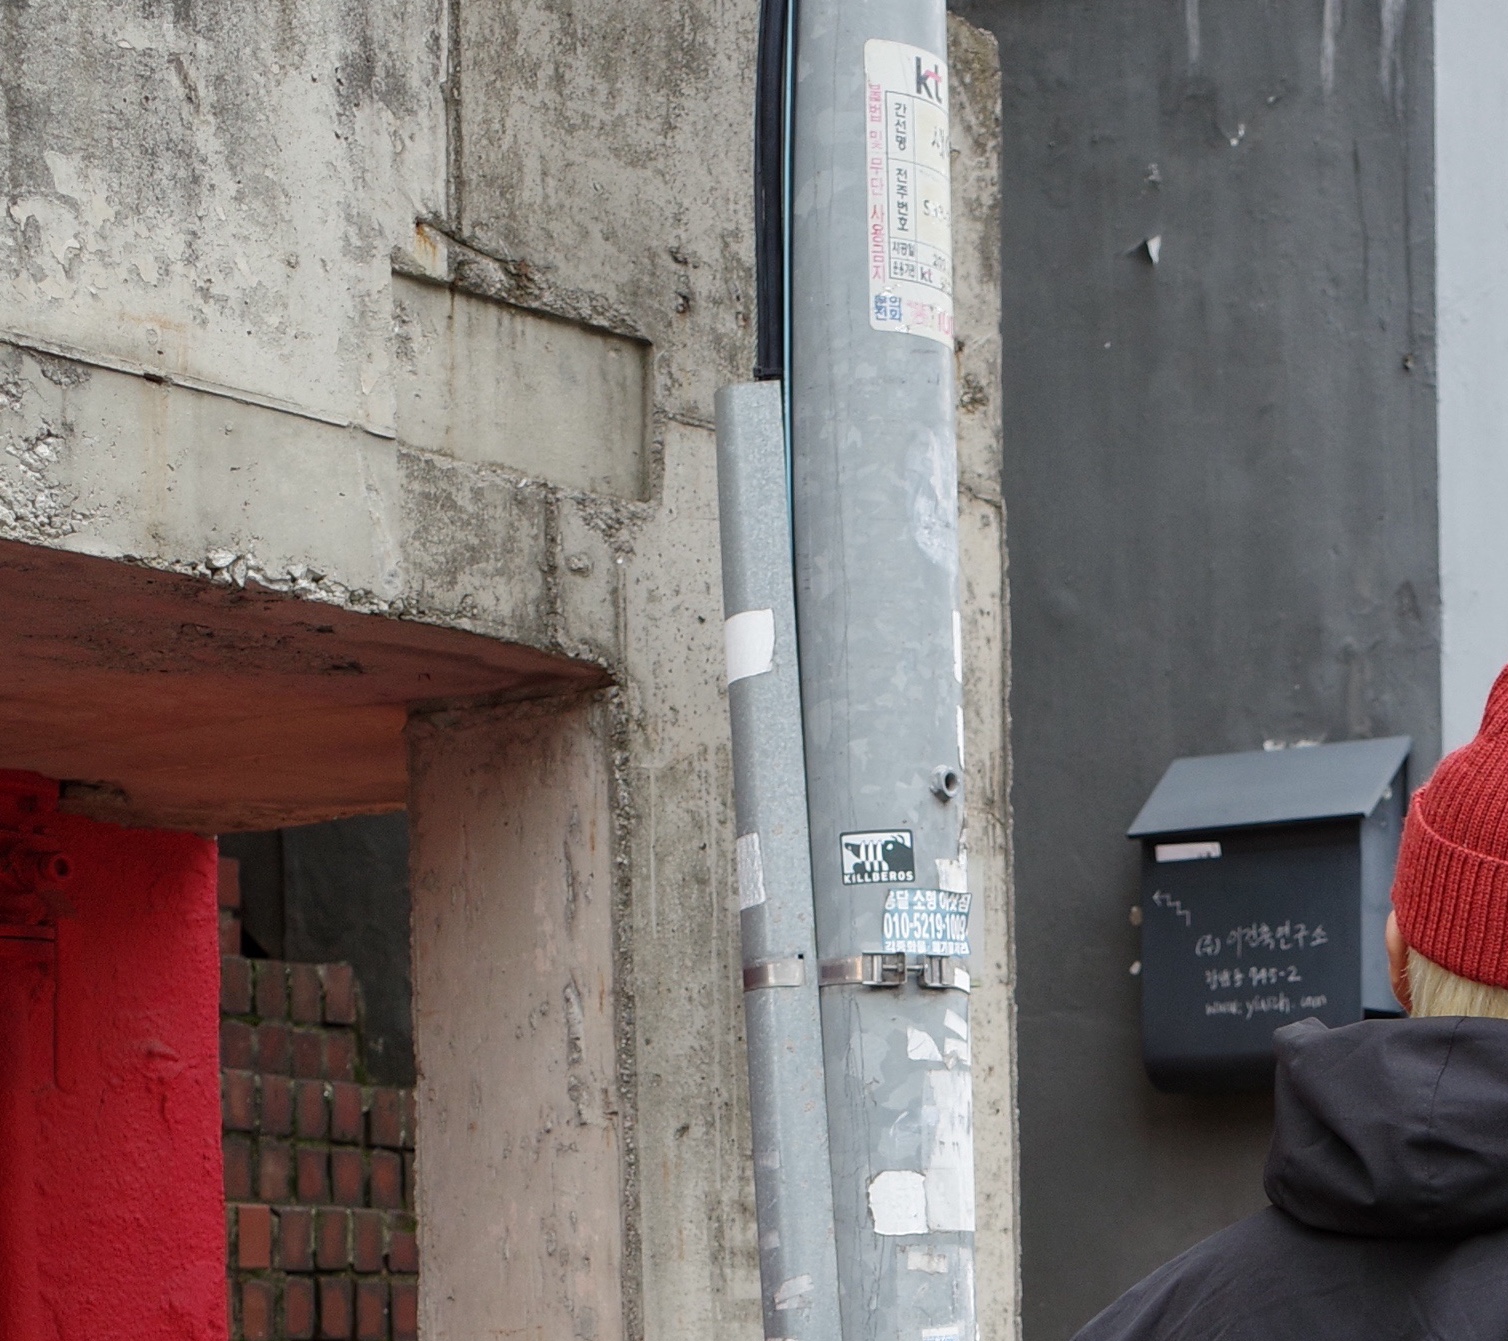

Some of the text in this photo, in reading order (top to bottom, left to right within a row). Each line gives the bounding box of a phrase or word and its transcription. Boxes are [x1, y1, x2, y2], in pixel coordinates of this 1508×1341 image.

[895, 167, 909, 232] 전주번호
[870, 204, 886, 283] 사용금지
[843, 870, 914, 884] KILLBEROS
[912, 889, 937, 911] 소형
